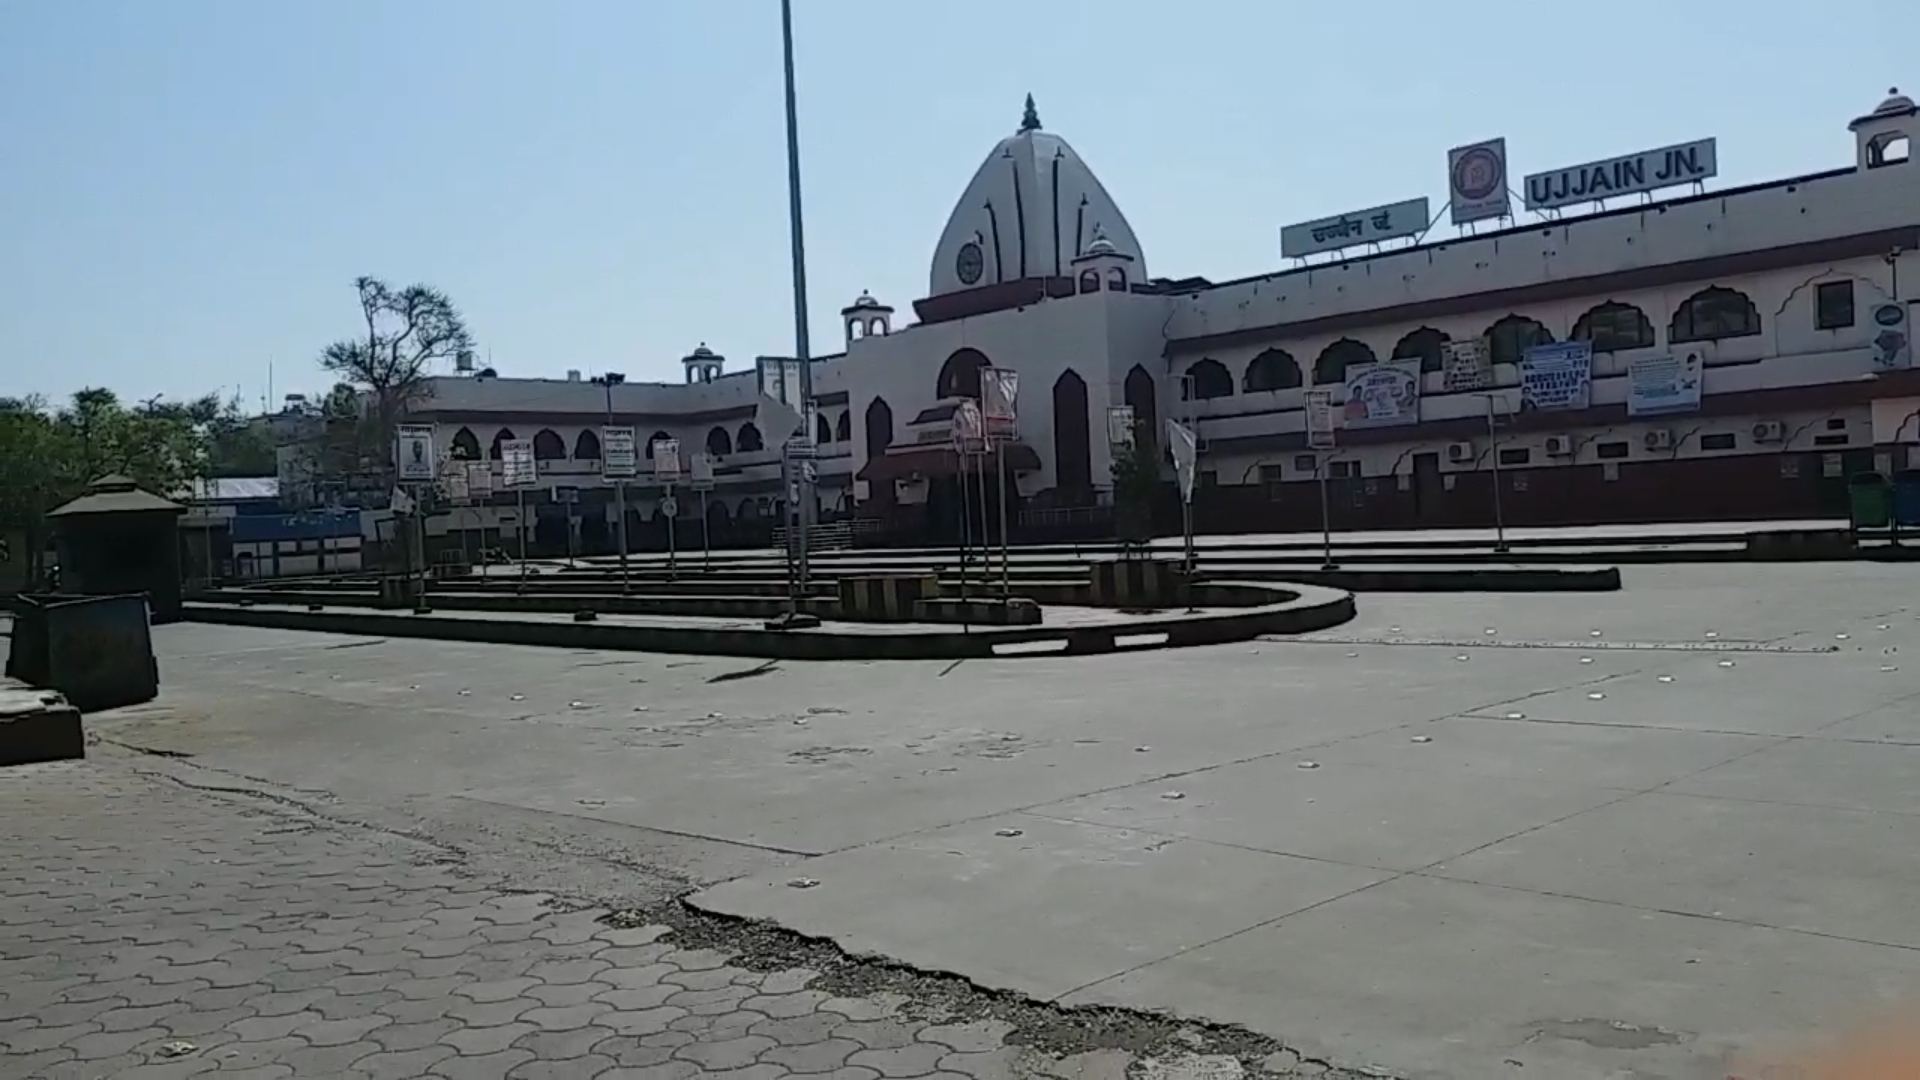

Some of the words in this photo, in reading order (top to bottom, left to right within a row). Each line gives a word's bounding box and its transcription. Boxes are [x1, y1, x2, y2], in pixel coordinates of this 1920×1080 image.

[1531, 157, 1645, 203] UJJAIN
[1655, 147, 1705, 180] JN.
[1310, 215, 1362, 243] उज्जैन
